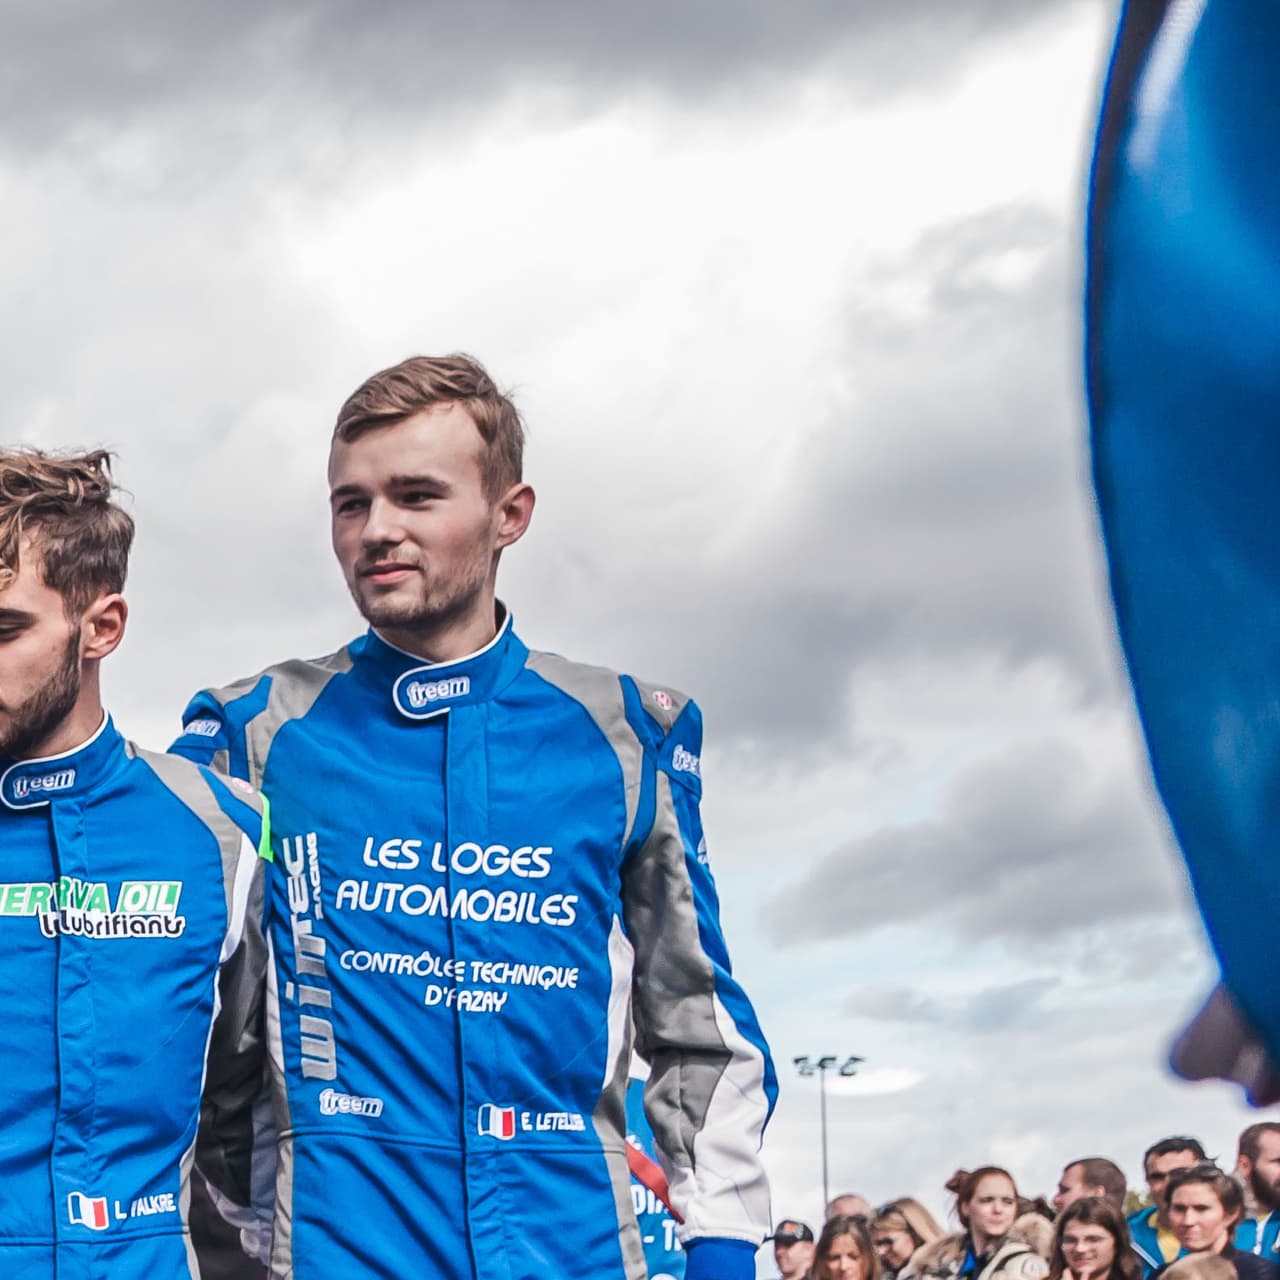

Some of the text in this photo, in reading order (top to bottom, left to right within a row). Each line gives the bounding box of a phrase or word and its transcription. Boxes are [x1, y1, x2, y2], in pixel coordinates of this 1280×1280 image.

[407, 677, 470, 708] freem
[13, 770, 75, 798] freem
[363, 837, 553, 879] LES LOGES
[119, 881, 180, 914] OIL
[336, 879, 579, 926] AUTOMOBILES
[470, 961, 579, 990] TECHNIQUE
[320, 1088, 383, 1117] freem
